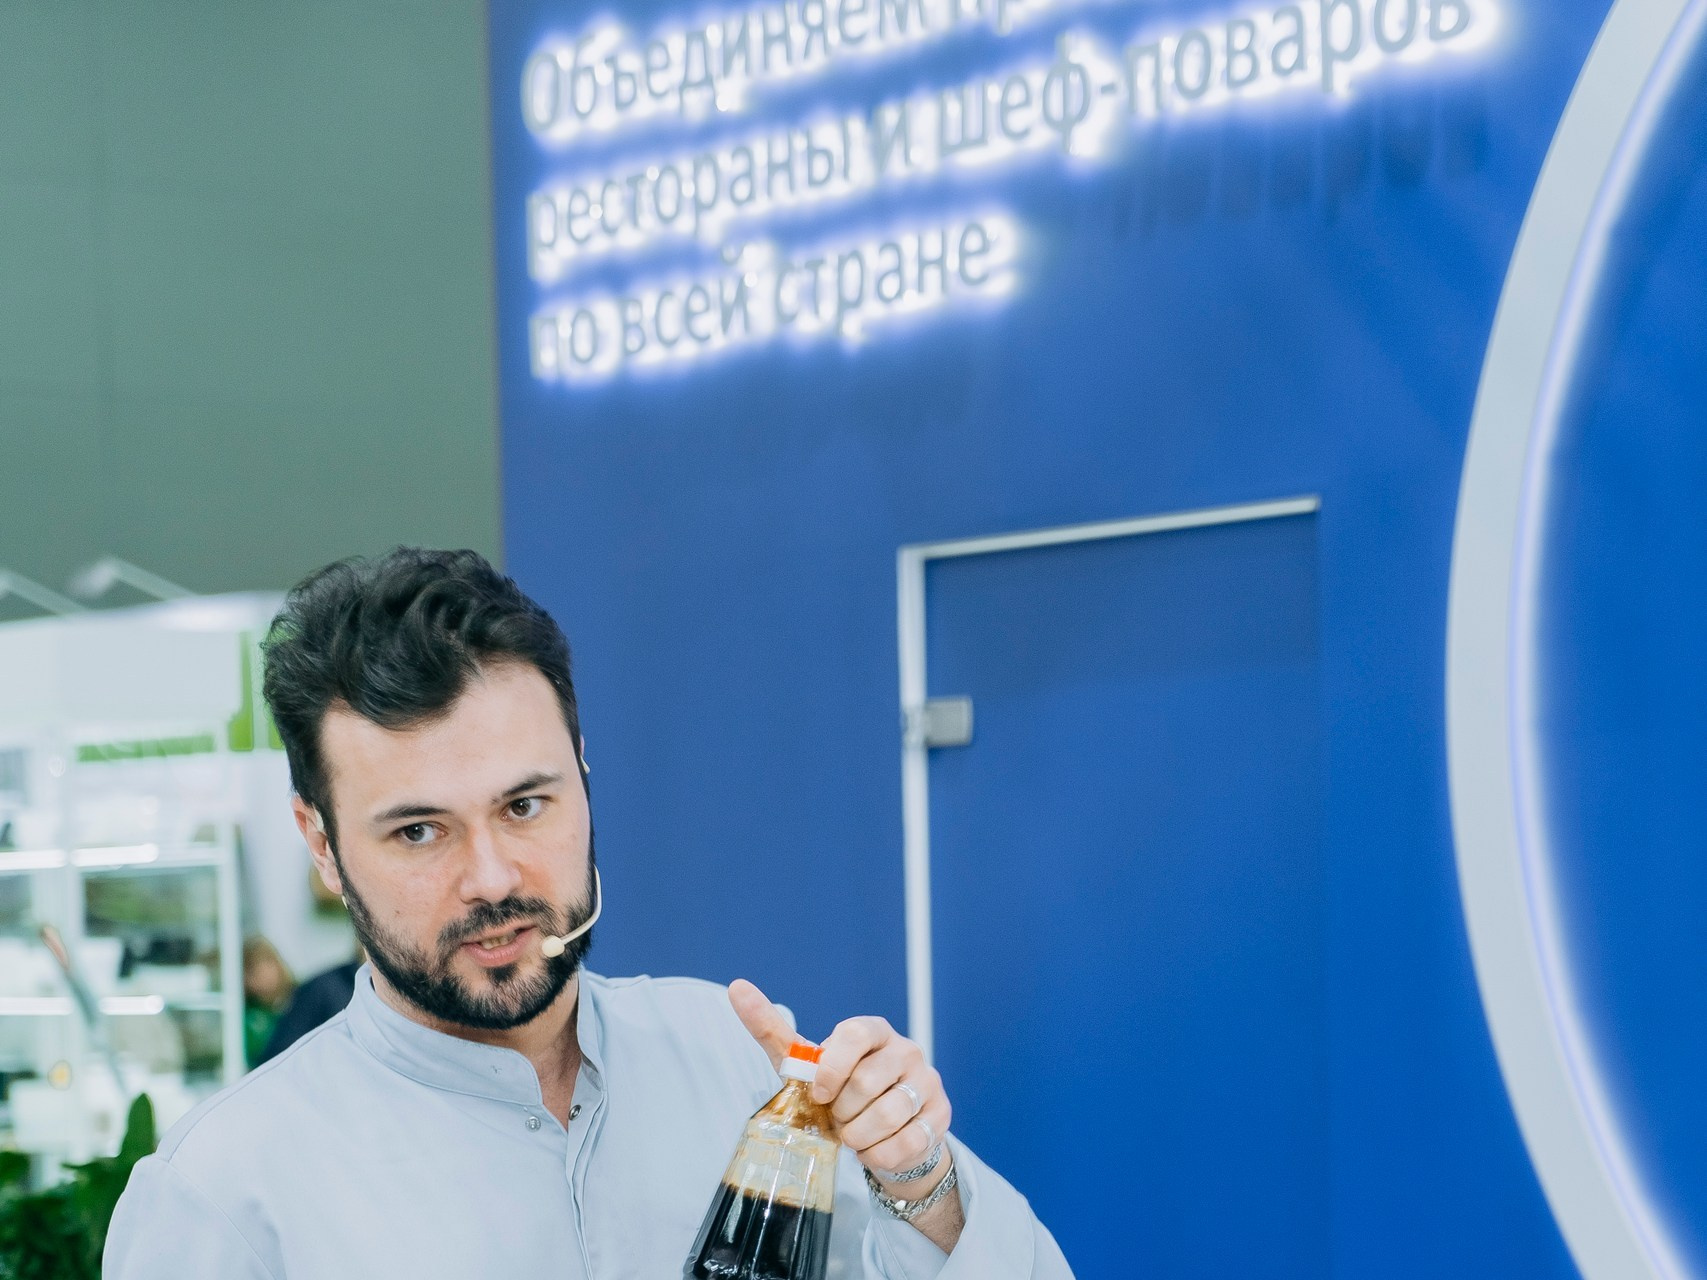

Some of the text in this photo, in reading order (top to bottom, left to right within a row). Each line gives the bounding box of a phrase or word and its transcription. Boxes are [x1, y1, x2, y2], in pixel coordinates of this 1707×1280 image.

[528, 0, 1470, 278] рестораны и шеф-поваров
[530, 222, 992, 379] по всей стране
